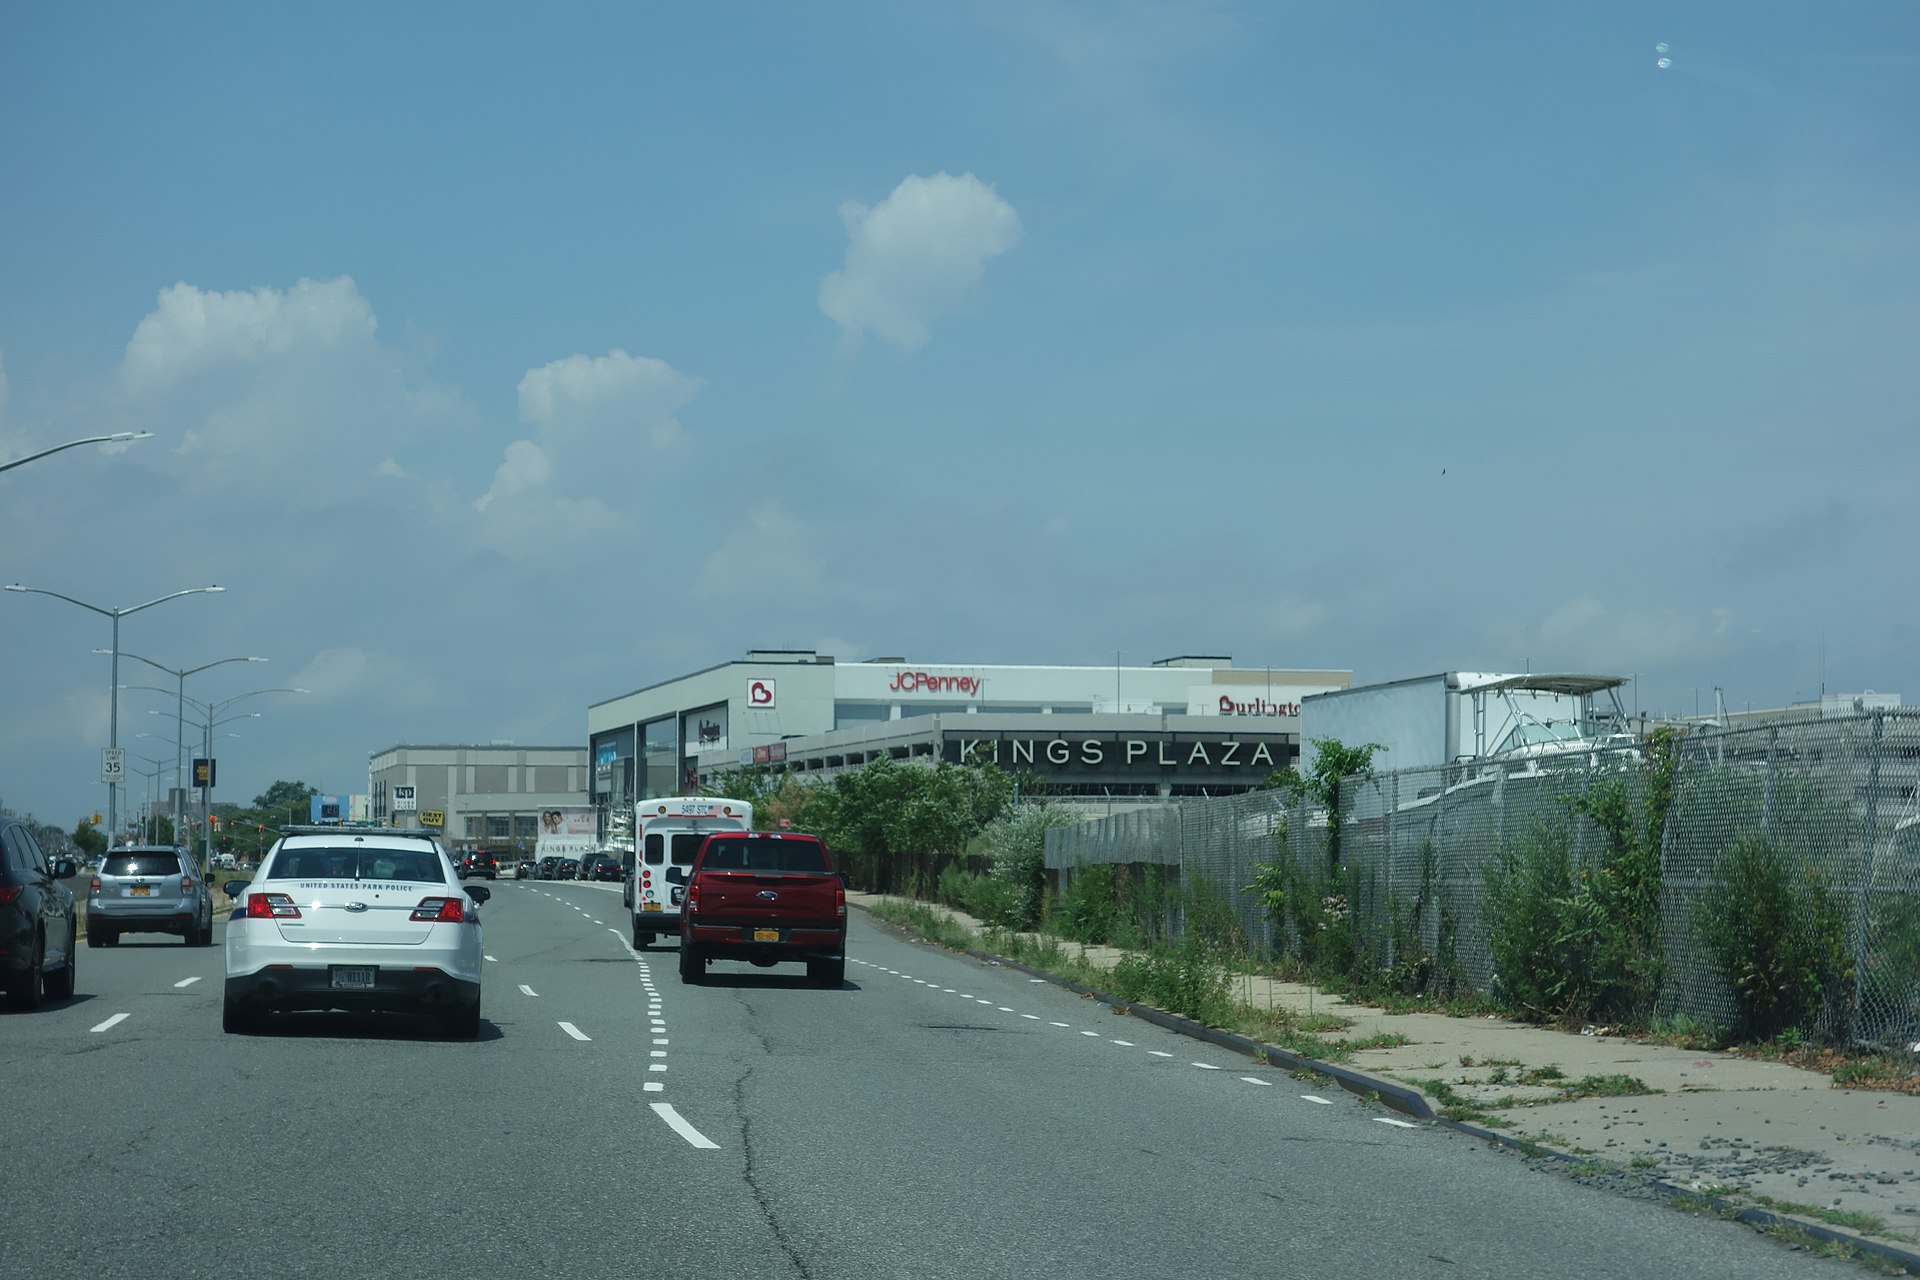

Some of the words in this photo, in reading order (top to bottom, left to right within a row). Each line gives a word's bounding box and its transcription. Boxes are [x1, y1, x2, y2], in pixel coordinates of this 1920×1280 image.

[889, 672, 980, 698] JCPenney
[1219, 695, 1300, 717] Burlingto
[960, 739, 1104, 765] KINGS
[1126, 740, 1274, 766] PLAZA
[105, 762, 121, 773] 35
[386, 884, 413, 892] POLICE
